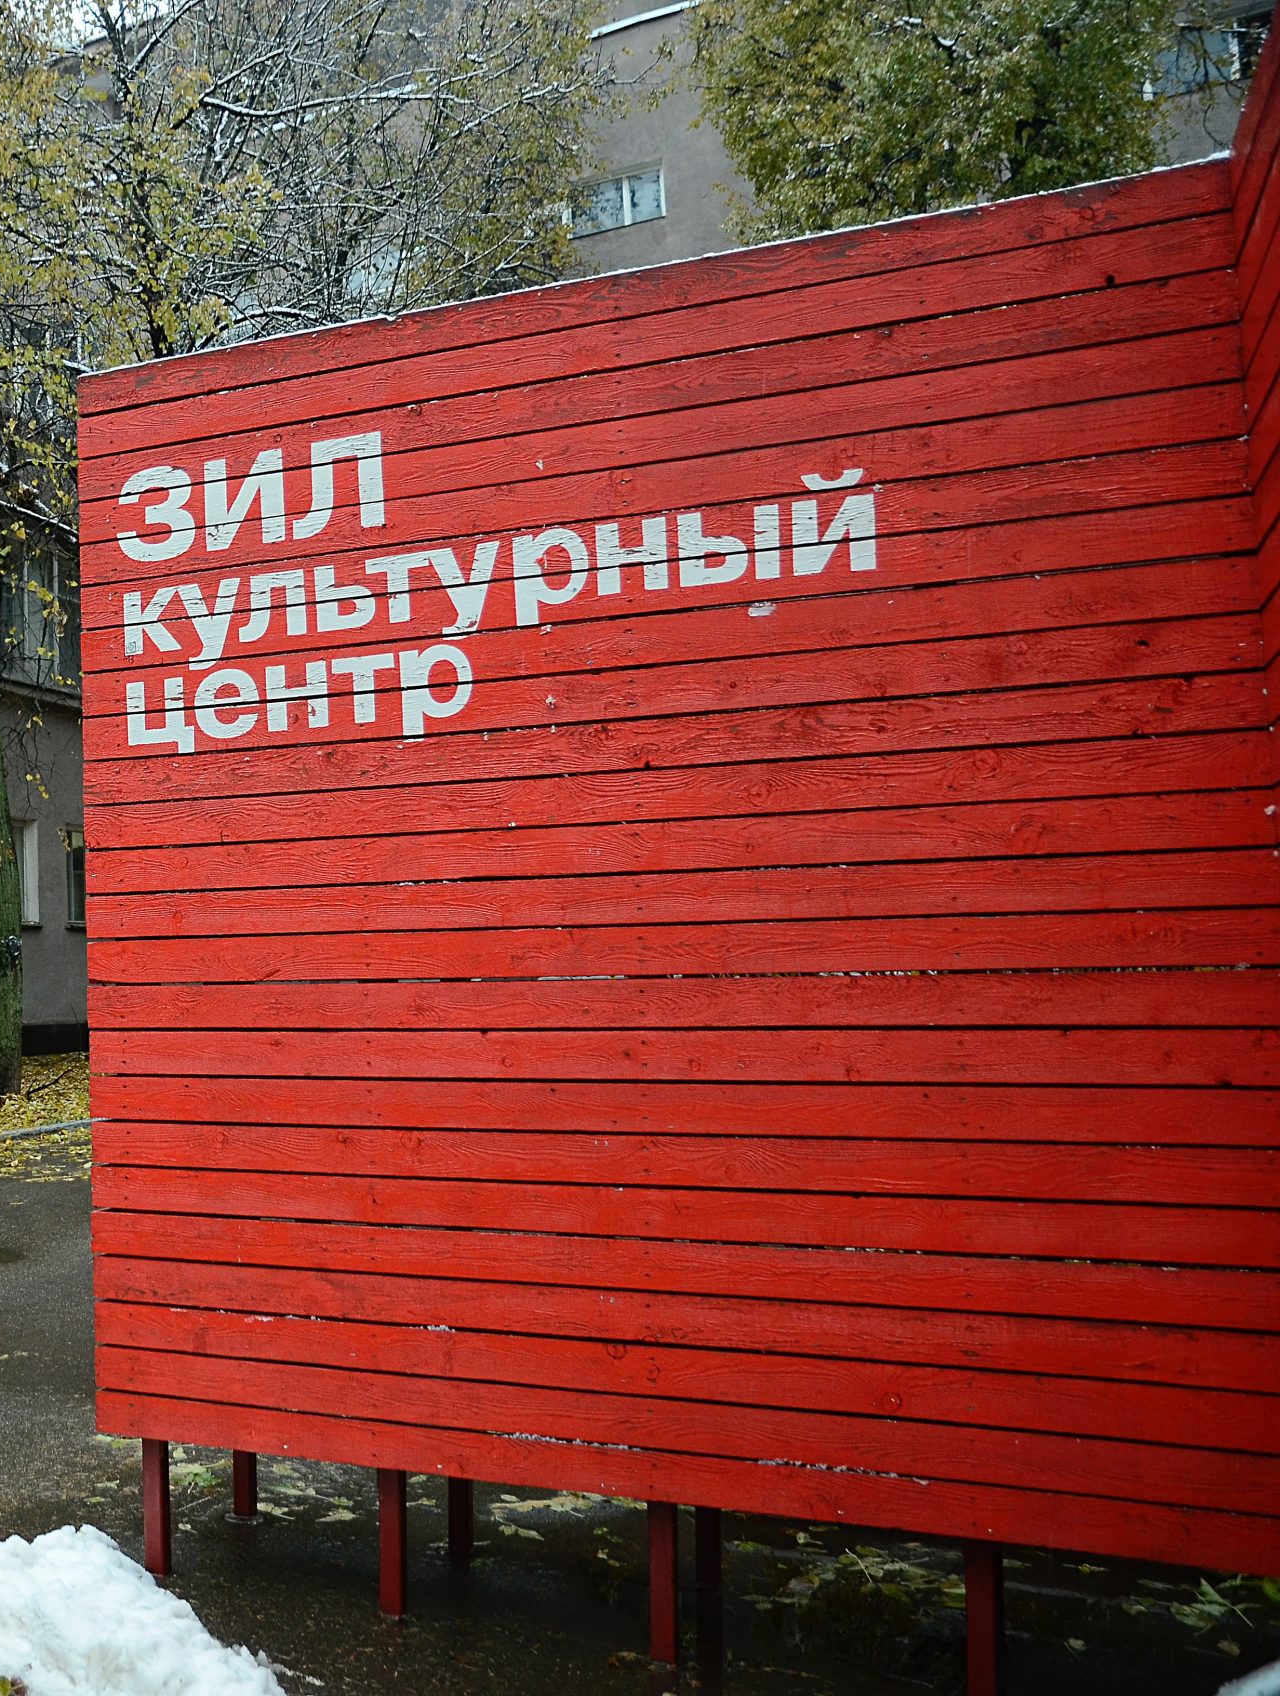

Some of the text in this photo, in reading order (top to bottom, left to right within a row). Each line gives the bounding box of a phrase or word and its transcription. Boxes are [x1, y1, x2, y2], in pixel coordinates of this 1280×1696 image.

[116, 431, 387, 562] ЗИЛ
[122, 468, 878, 670] культурный
[125, 644, 473, 754] центр
